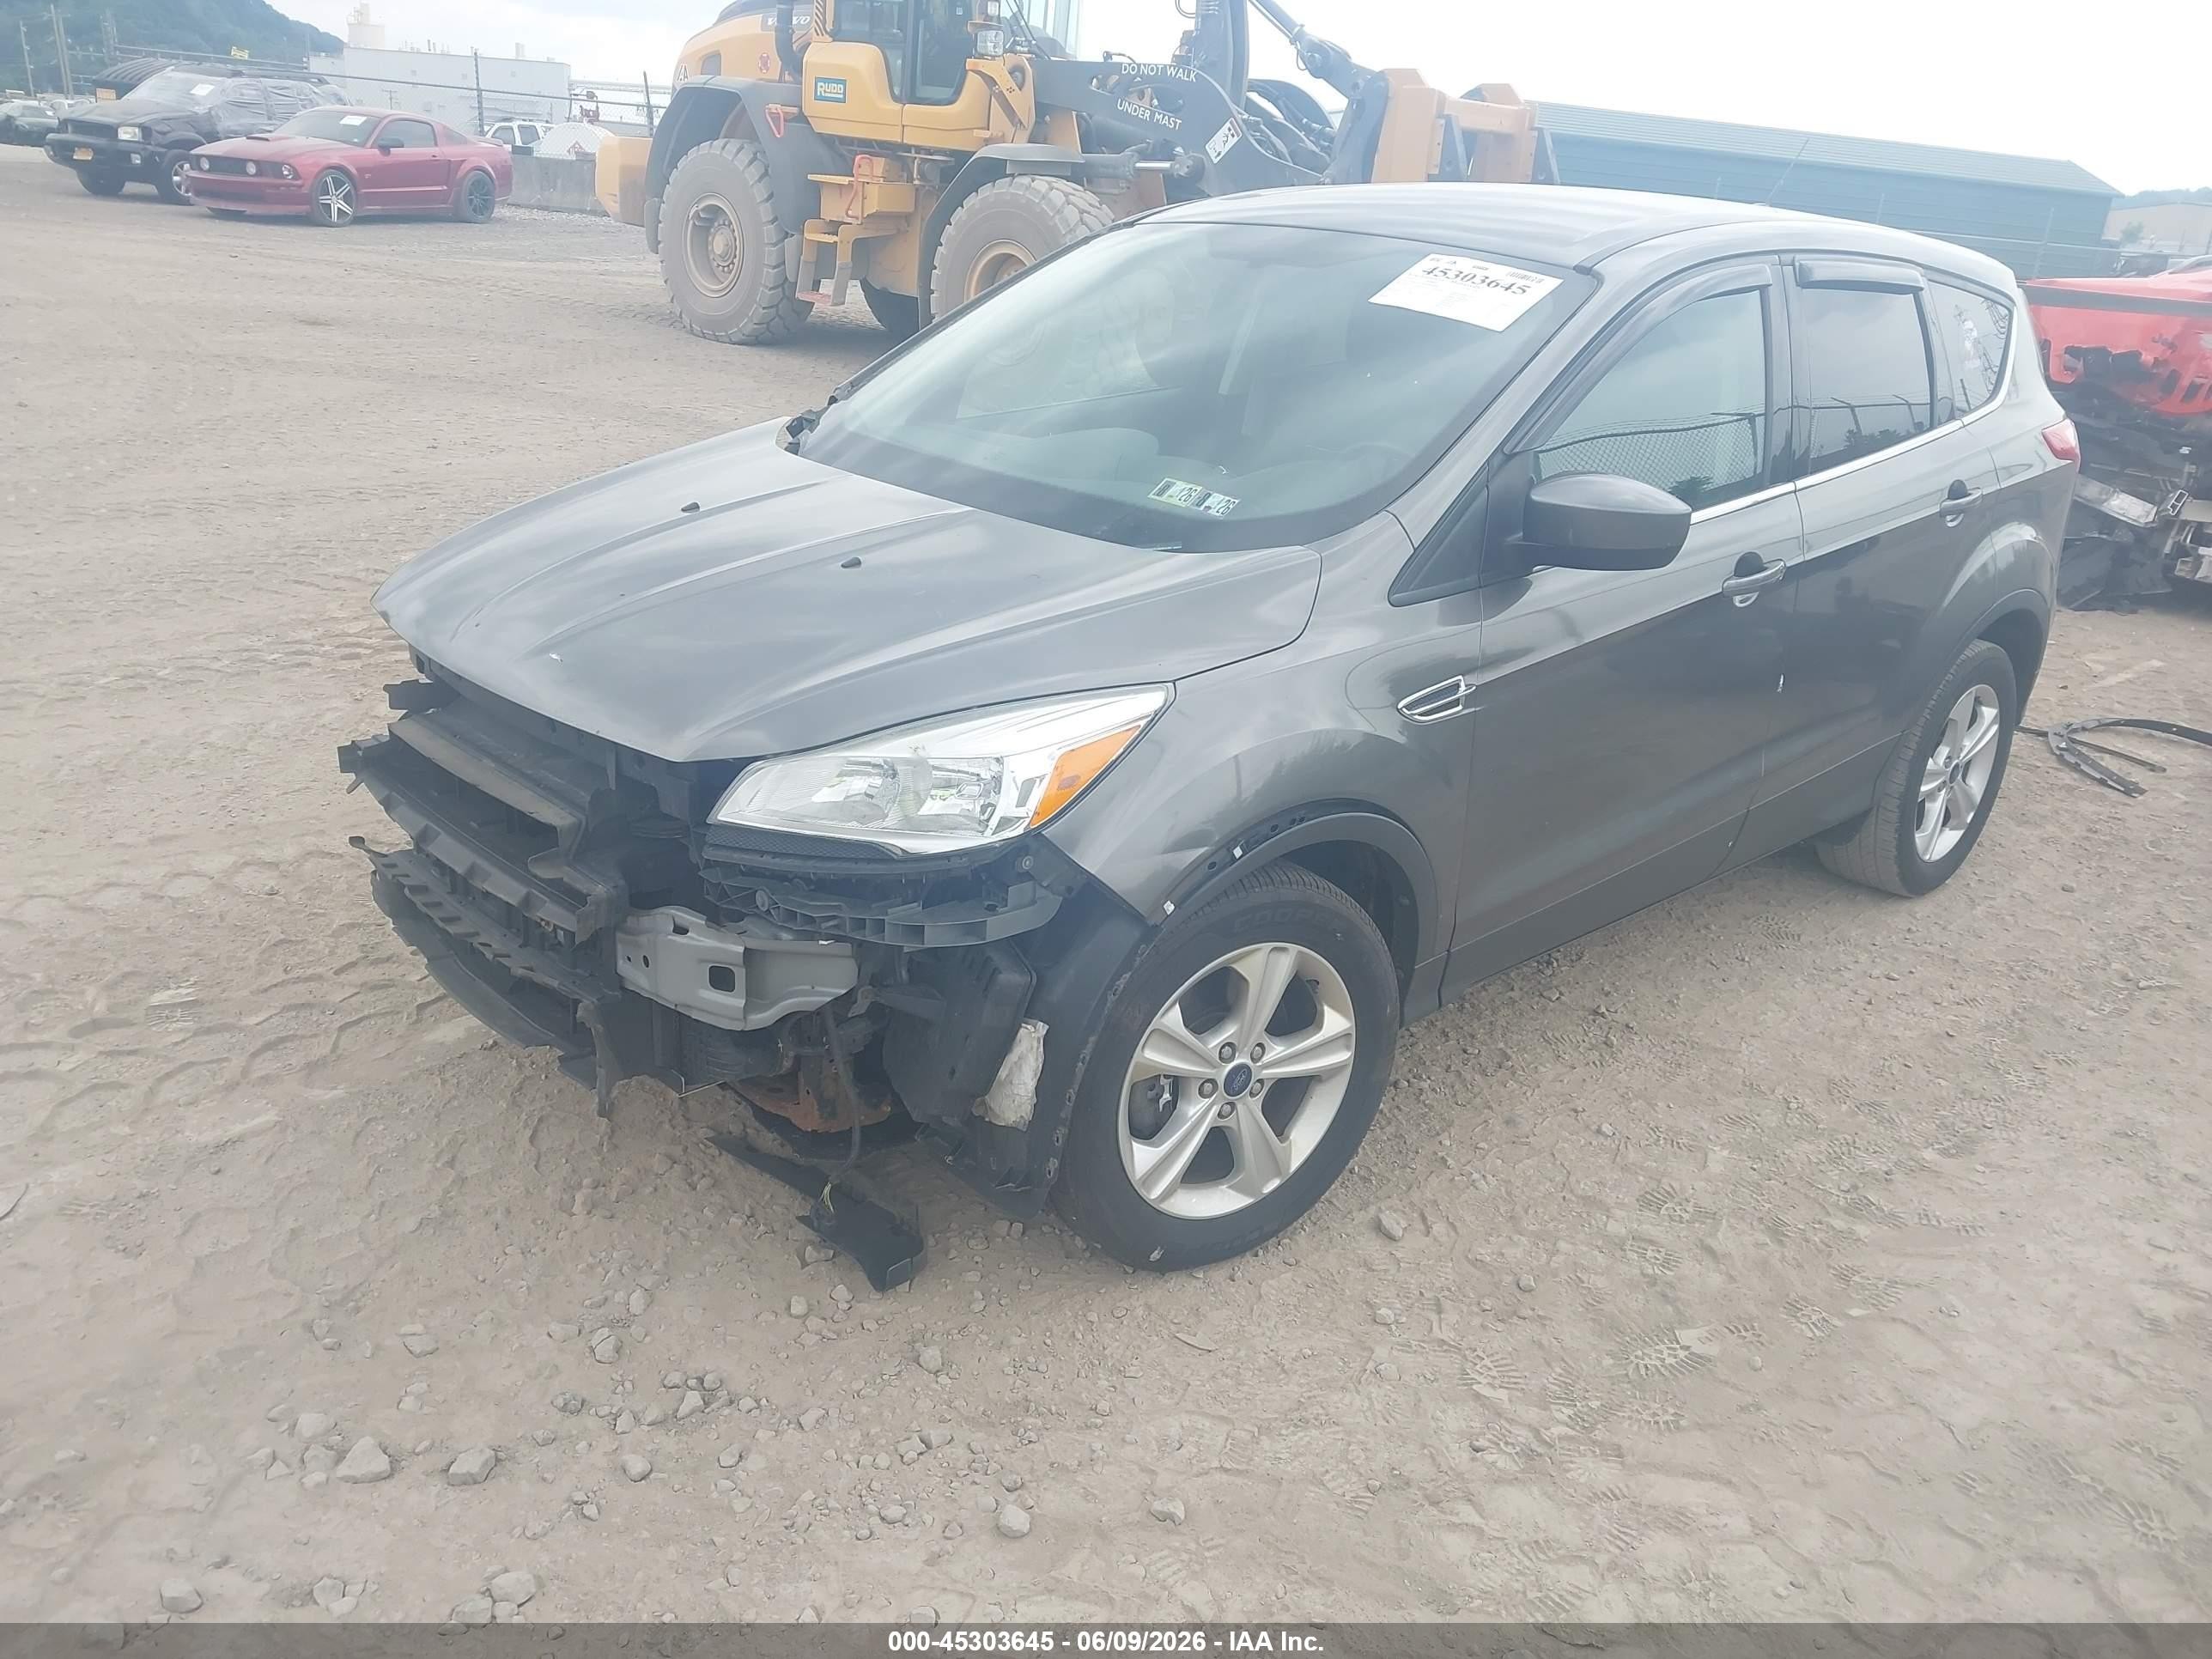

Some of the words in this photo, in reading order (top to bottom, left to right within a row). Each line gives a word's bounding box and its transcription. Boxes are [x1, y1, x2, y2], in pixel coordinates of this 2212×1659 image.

[767, 15, 811, 26] VVO
[1121, 63, 1138, 75] DO
[1139, 64, 1164, 76] NOT
[1167, 65, 1197, 82] WALK
[817, 82, 844, 97] RUDD
[1117, 98, 1151, 121] UNDER
[1153, 112, 1182, 131] MAST
[1421, 264, 1532, 295] 45303645
